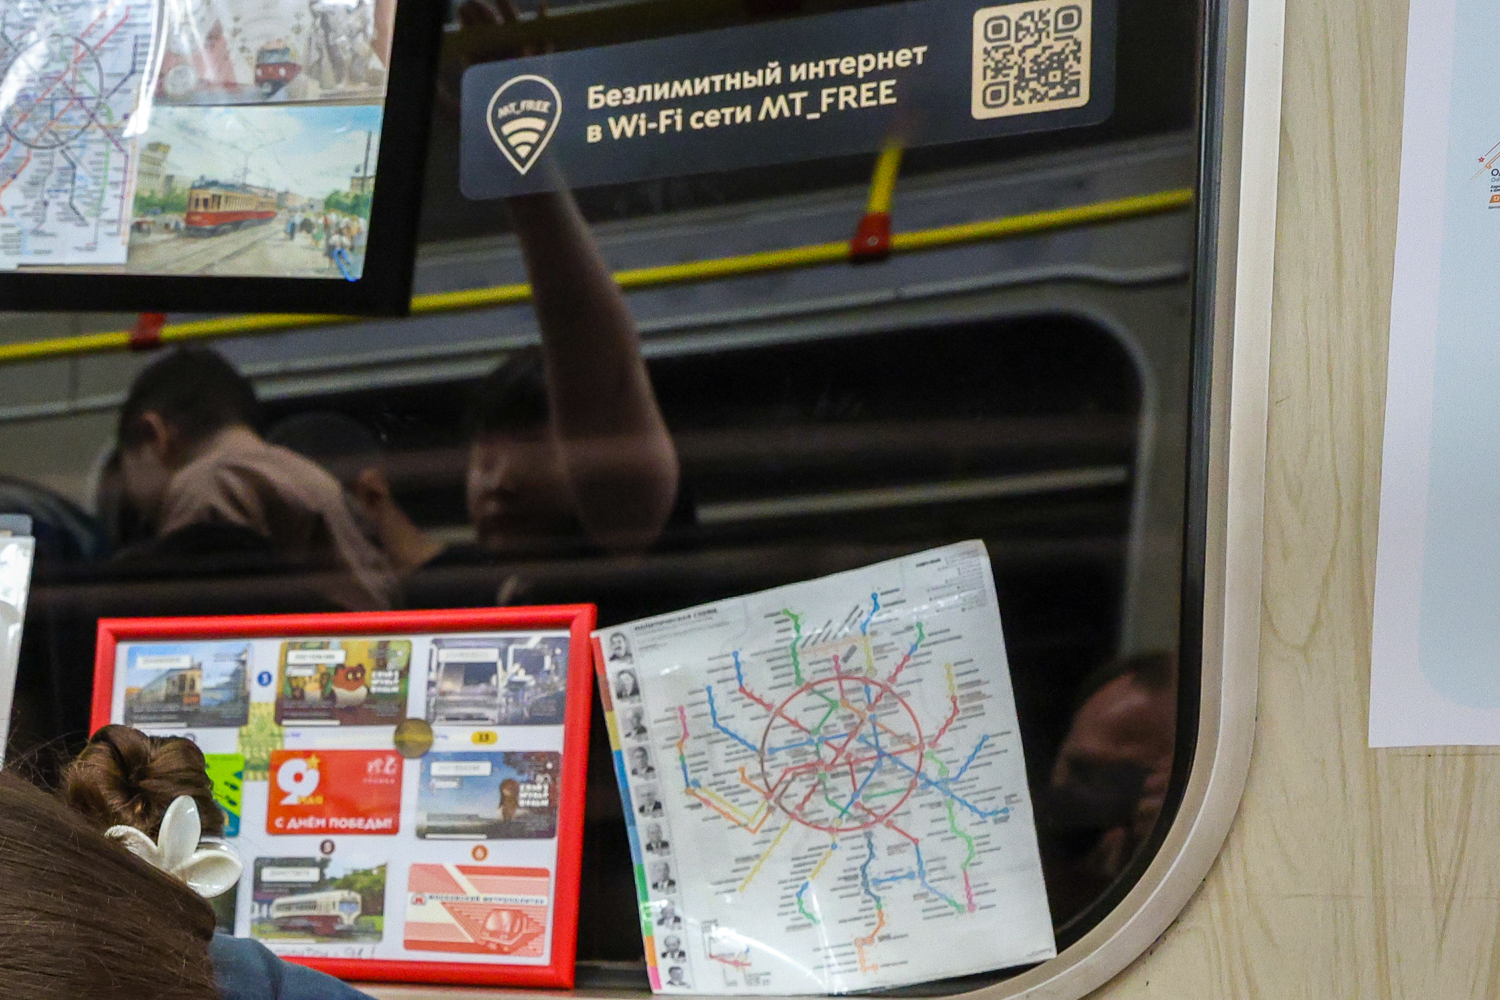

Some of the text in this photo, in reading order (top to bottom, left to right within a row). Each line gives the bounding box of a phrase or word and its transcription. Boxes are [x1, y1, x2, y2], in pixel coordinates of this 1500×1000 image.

[587, 45, 928, 110] Безлимитный интернет
[586, 79, 897, 143] в Wi-Fi сети MT_FREE
